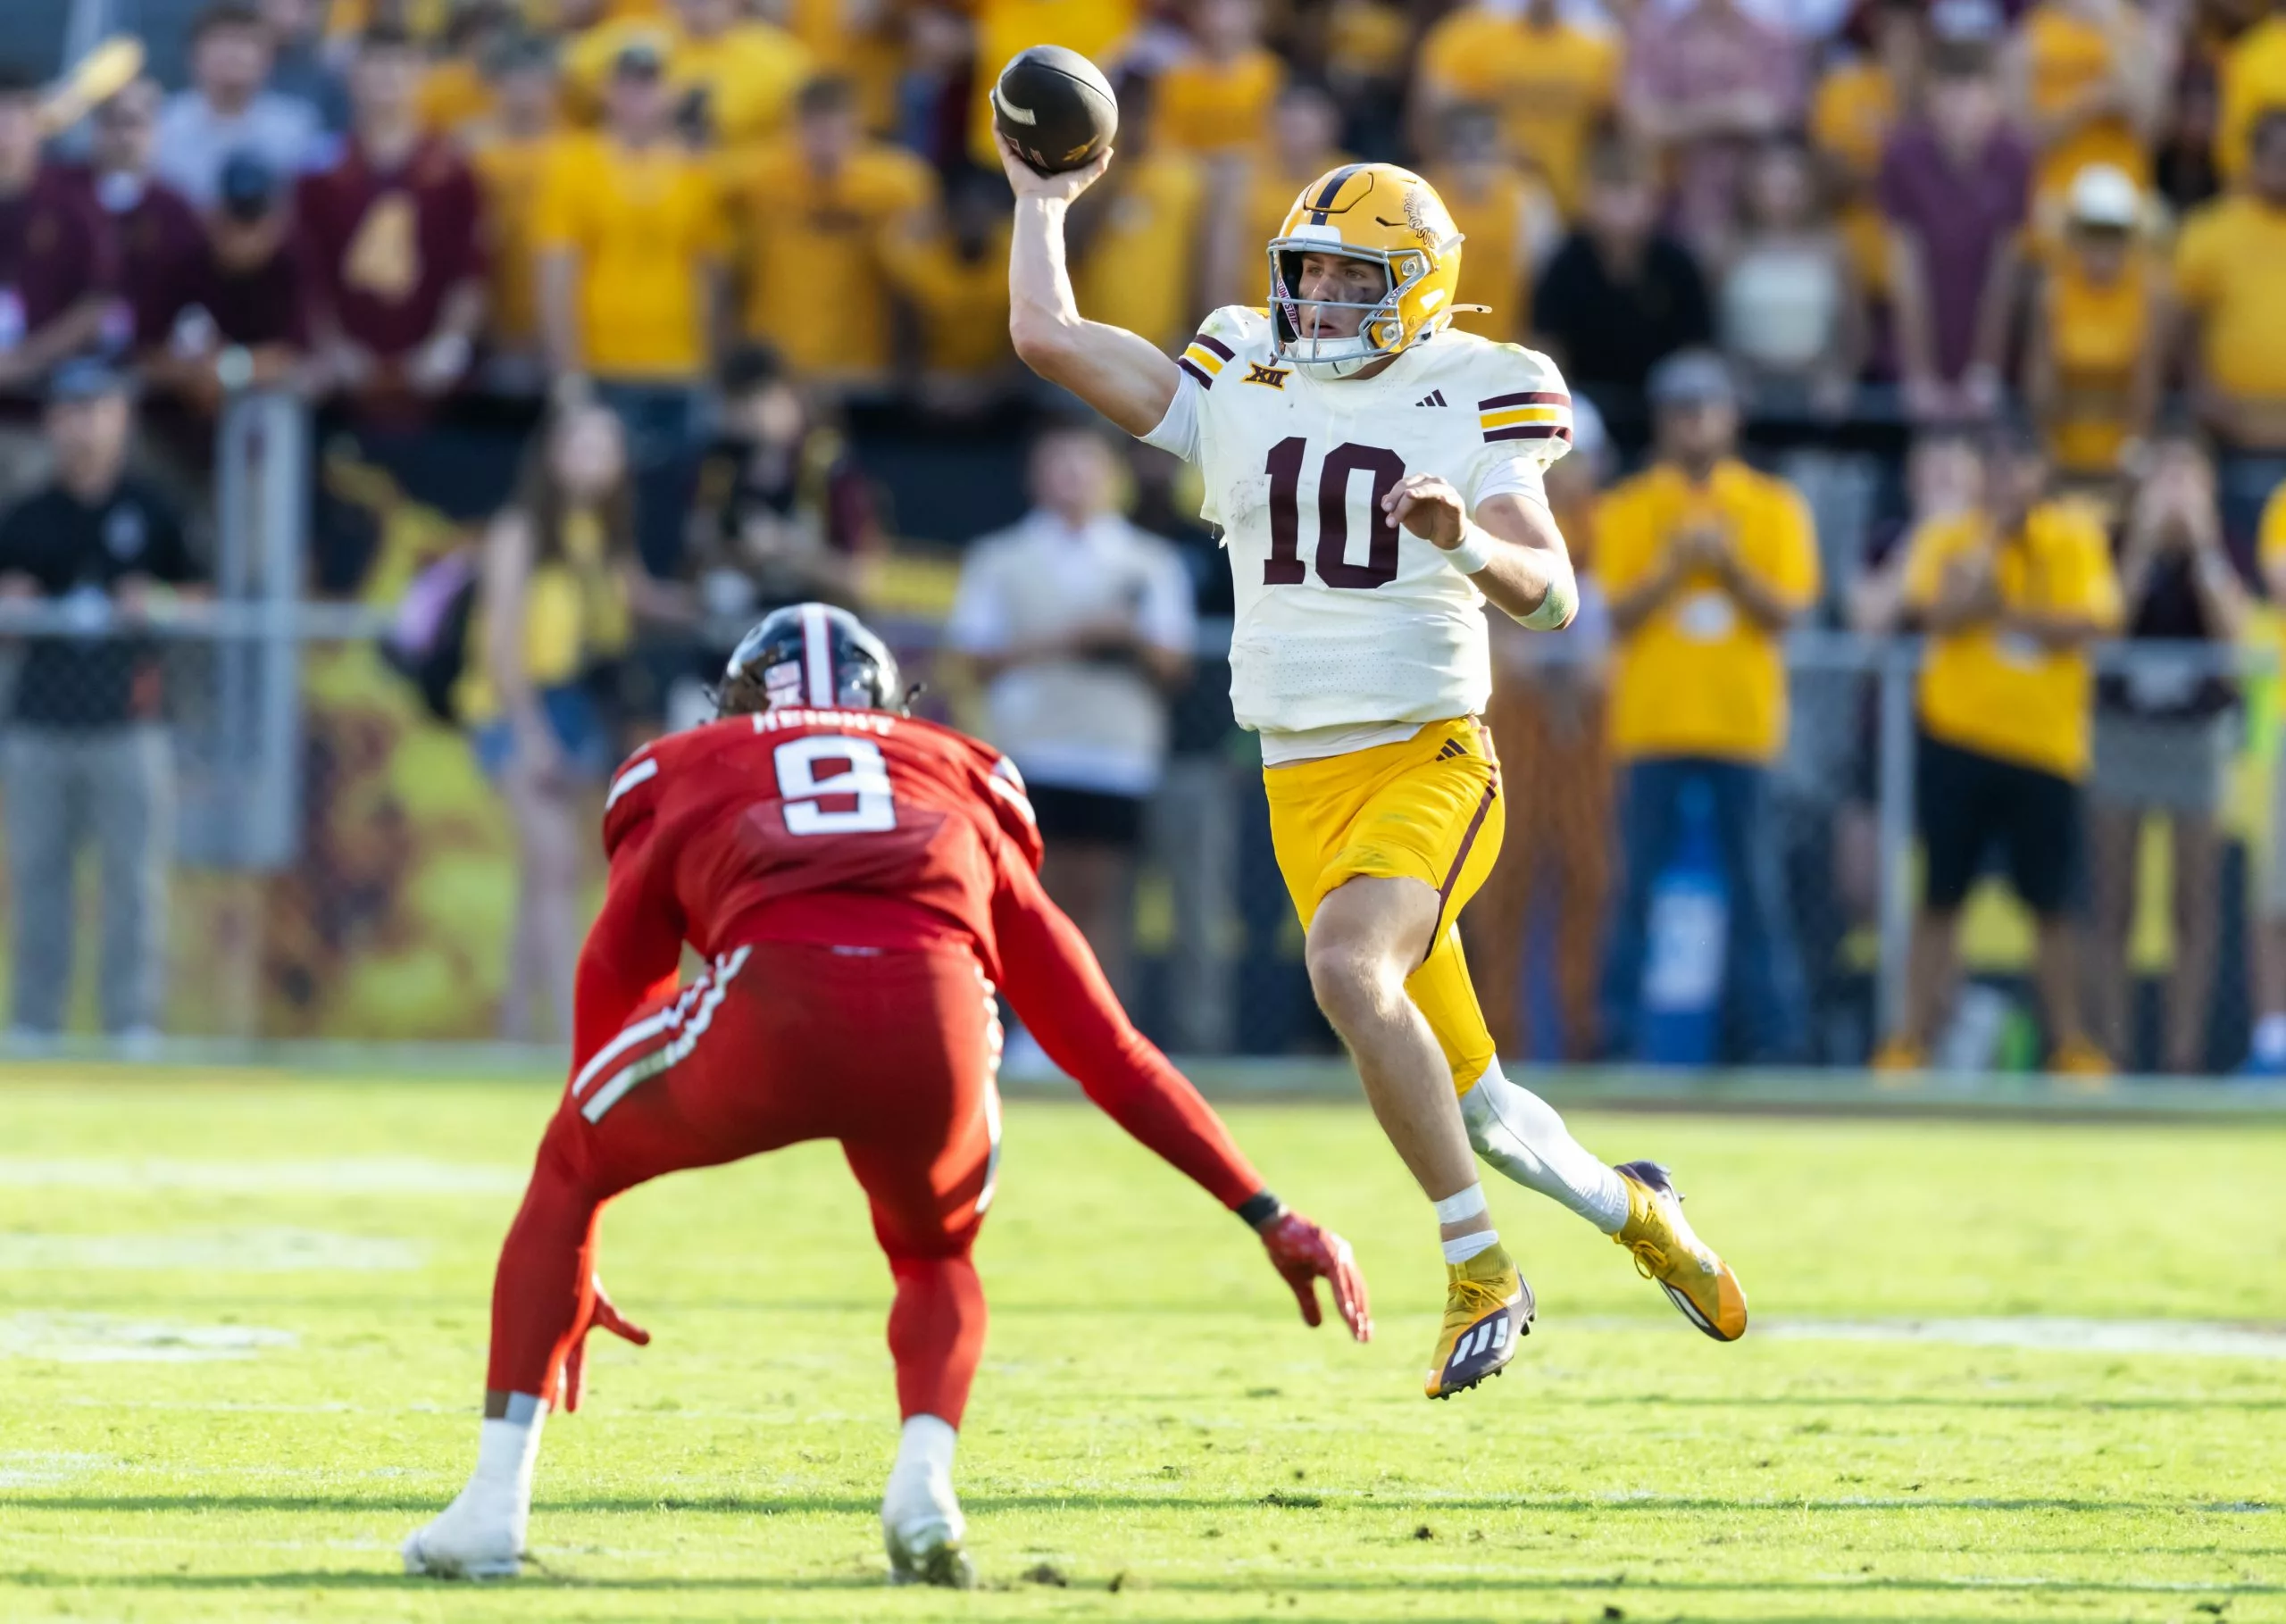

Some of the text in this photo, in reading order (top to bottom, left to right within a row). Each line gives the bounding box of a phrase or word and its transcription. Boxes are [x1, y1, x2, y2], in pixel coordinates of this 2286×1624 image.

[1285, 304, 1297, 325] STATE
[1243, 362, 1291, 388] XII
[1263, 437, 1406, 589] 10
[773, 735, 897, 836] 9
